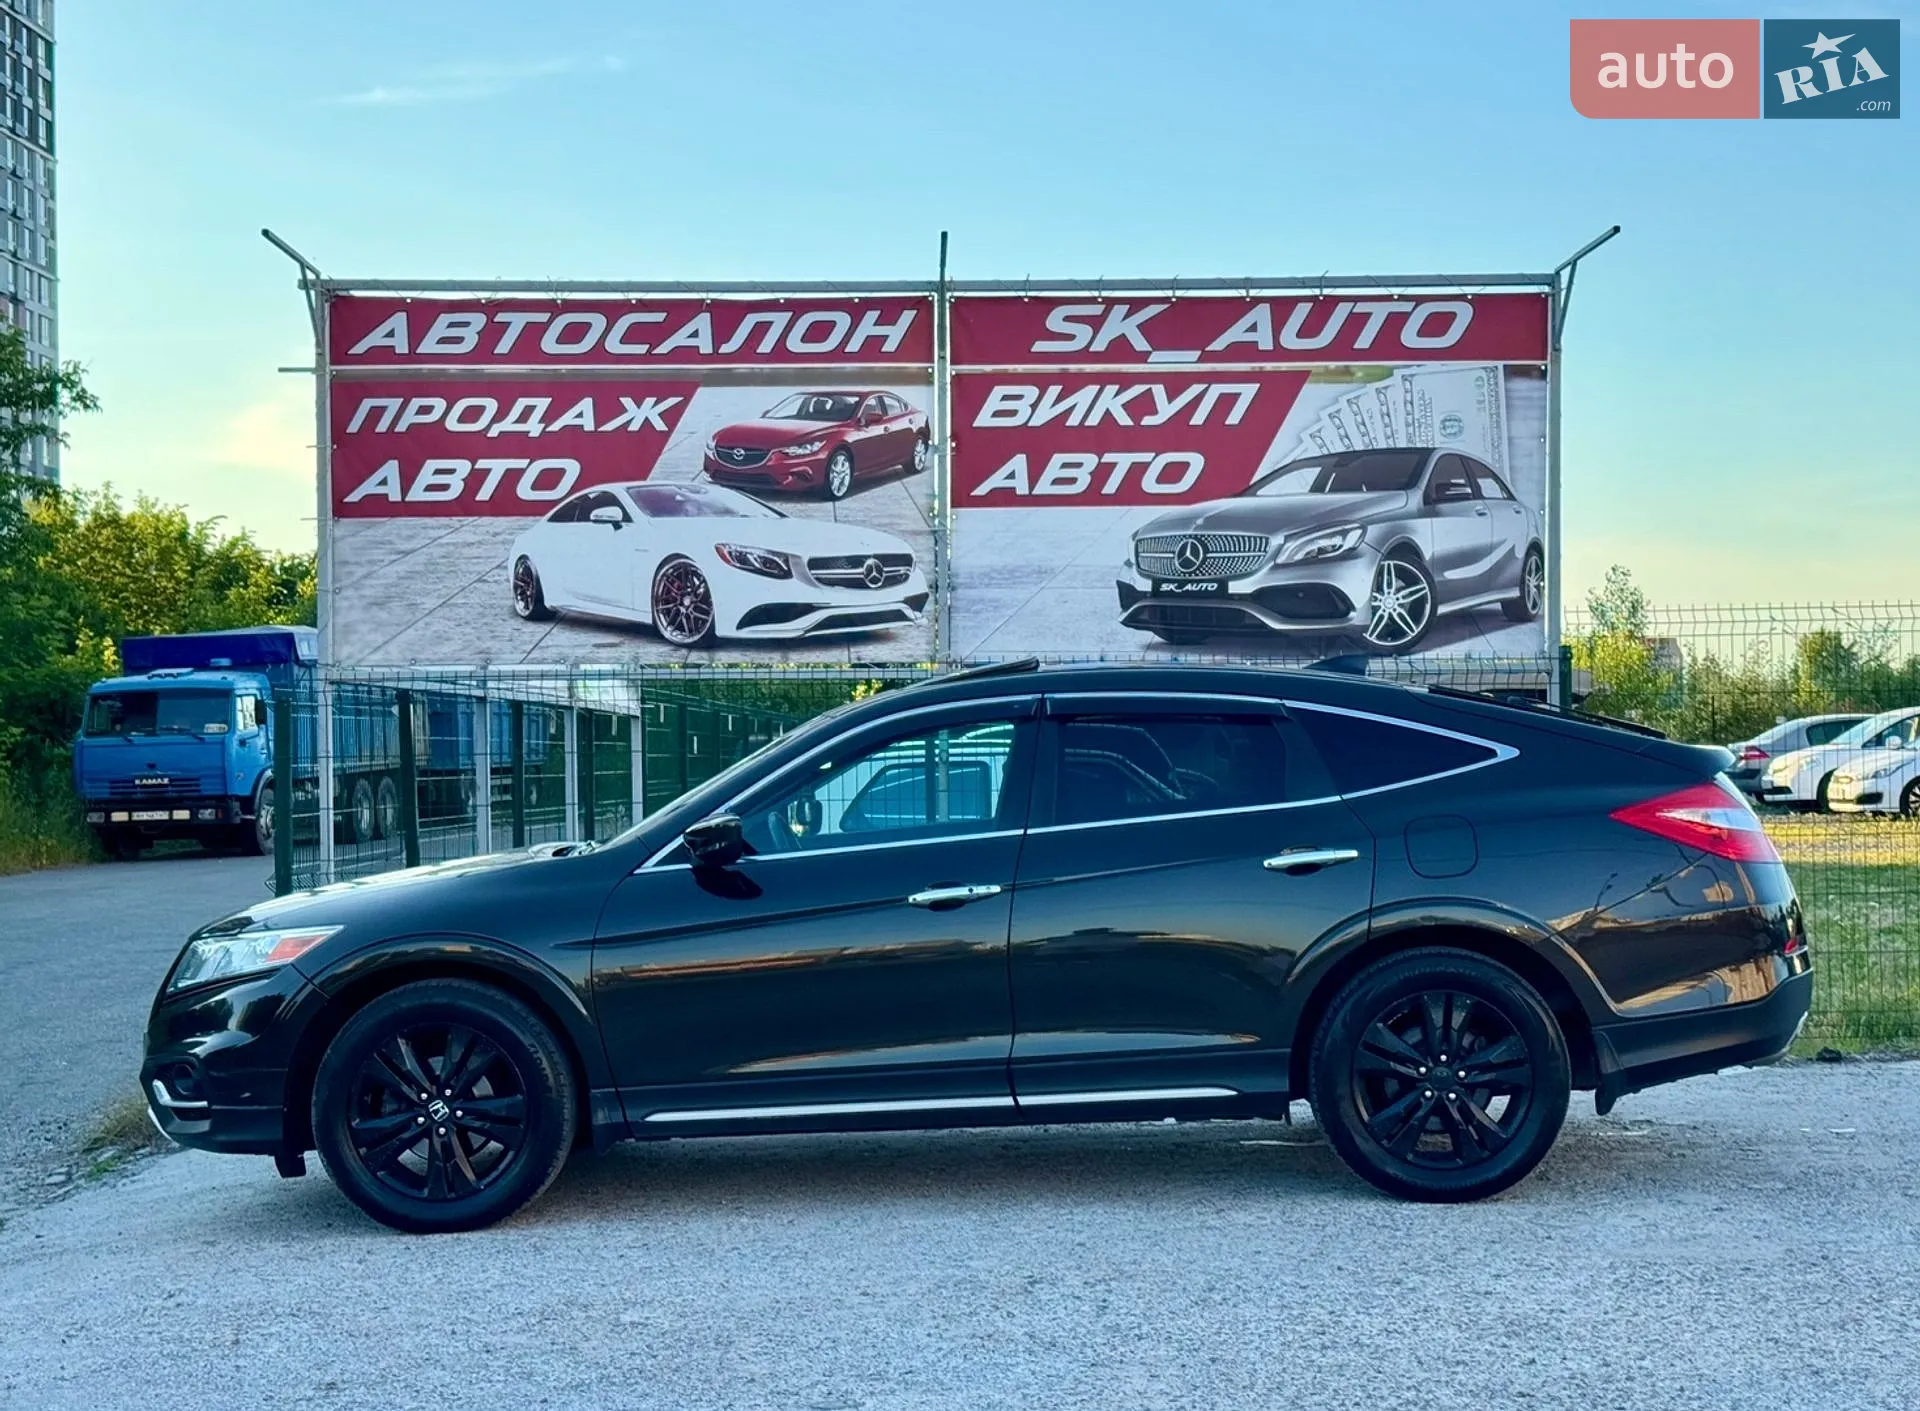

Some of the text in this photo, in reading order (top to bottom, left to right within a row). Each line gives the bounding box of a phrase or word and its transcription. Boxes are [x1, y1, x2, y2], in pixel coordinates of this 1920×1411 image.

[347, 310, 918, 355] АВТОСАЛОН
[1030, 301, 1475, 363] SK_AUTO
[345, 396, 686, 438] ПРОДАЖ
[972, 383, 1261, 428] ВИКУП
[343, 458, 581, 503] АВТО
[970, 451, 1205, 497] АВТО
[1159, 582, 1218, 593] SK_AUTO
